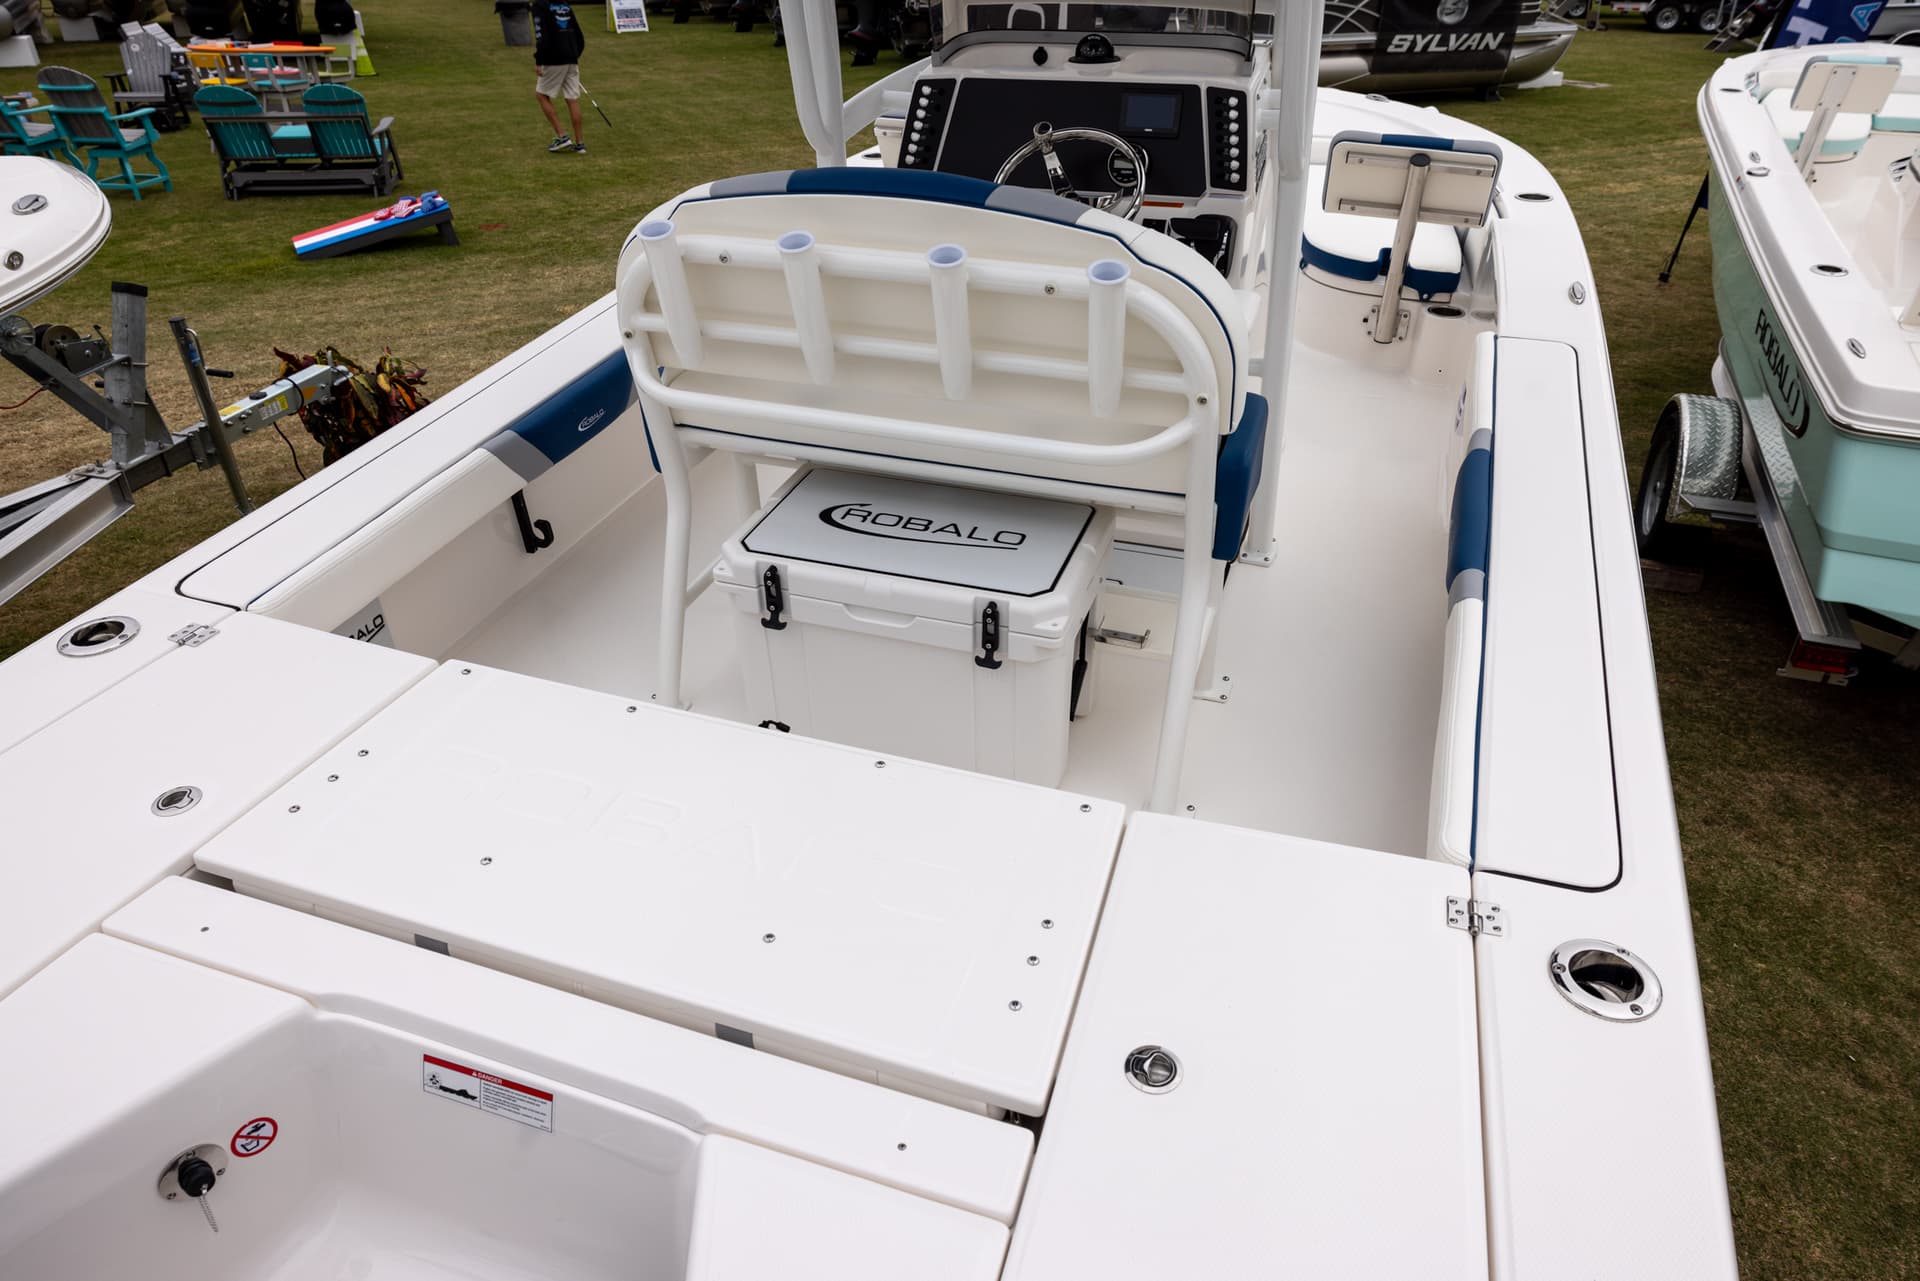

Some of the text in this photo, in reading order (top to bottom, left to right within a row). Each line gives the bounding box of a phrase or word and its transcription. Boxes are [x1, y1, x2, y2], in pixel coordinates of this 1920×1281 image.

[1387, 32, 1505, 52] SYLVAN
[840, 506, 1027, 546] ROBALO
[349, 613, 385, 641] ALO
[478, 1072, 503, 1085] DANGER
